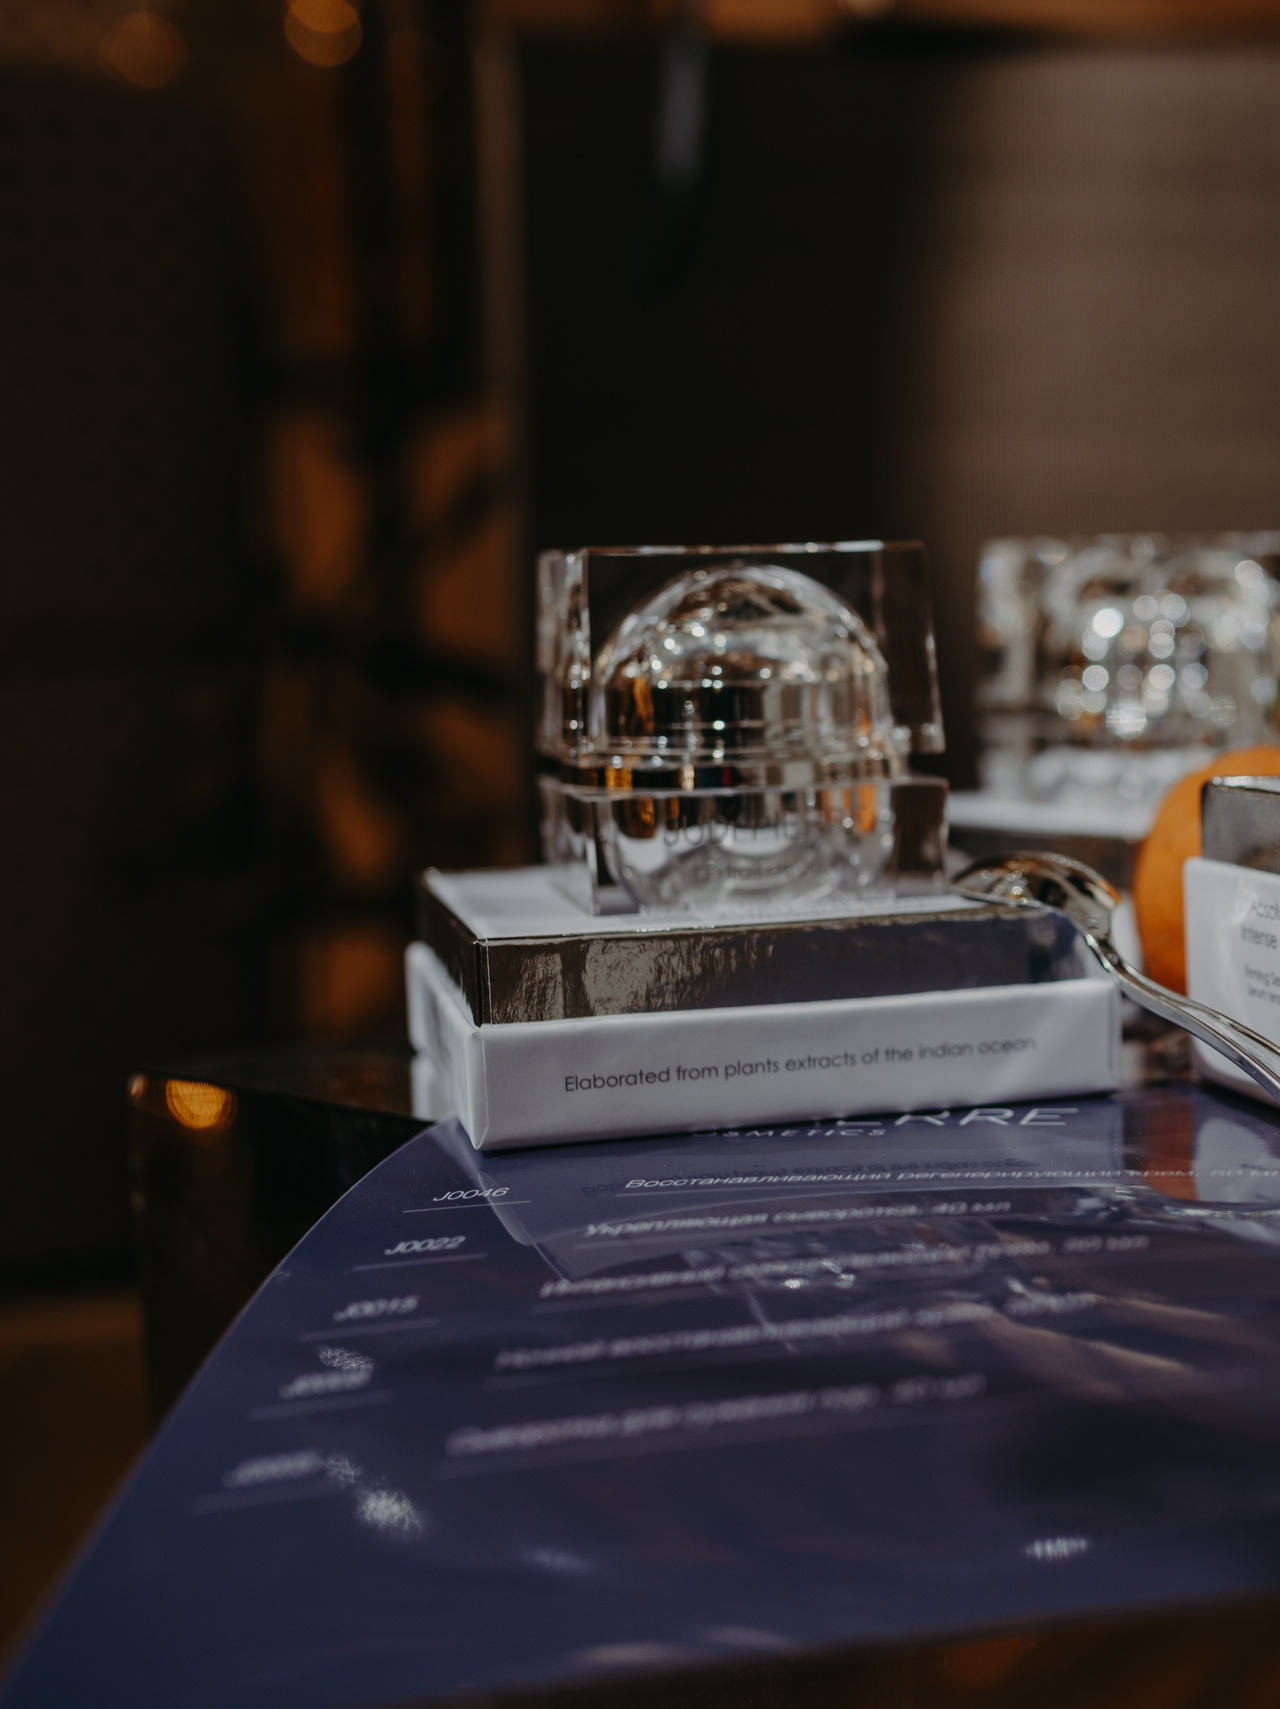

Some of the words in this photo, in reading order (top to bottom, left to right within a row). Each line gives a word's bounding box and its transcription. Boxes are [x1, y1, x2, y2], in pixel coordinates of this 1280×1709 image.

[564, 1066, 671, 1092] Elaborated
[675, 1065, 719, 1082] from
[724, 1057, 780, 1081] plants
[784, 1051, 857, 1072] extracts
[861, 1047, 880, 1065] of
[884, 1046, 914, 1062] the
[918, 1042, 975, 1060] indian
[978, 1037, 1038, 1055] ocean
[624, 1172, 891, 1189] Восстанавливающий
[432, 1187, 510, 1202] J0046
[384, 1235, 466, 1256] J0022
